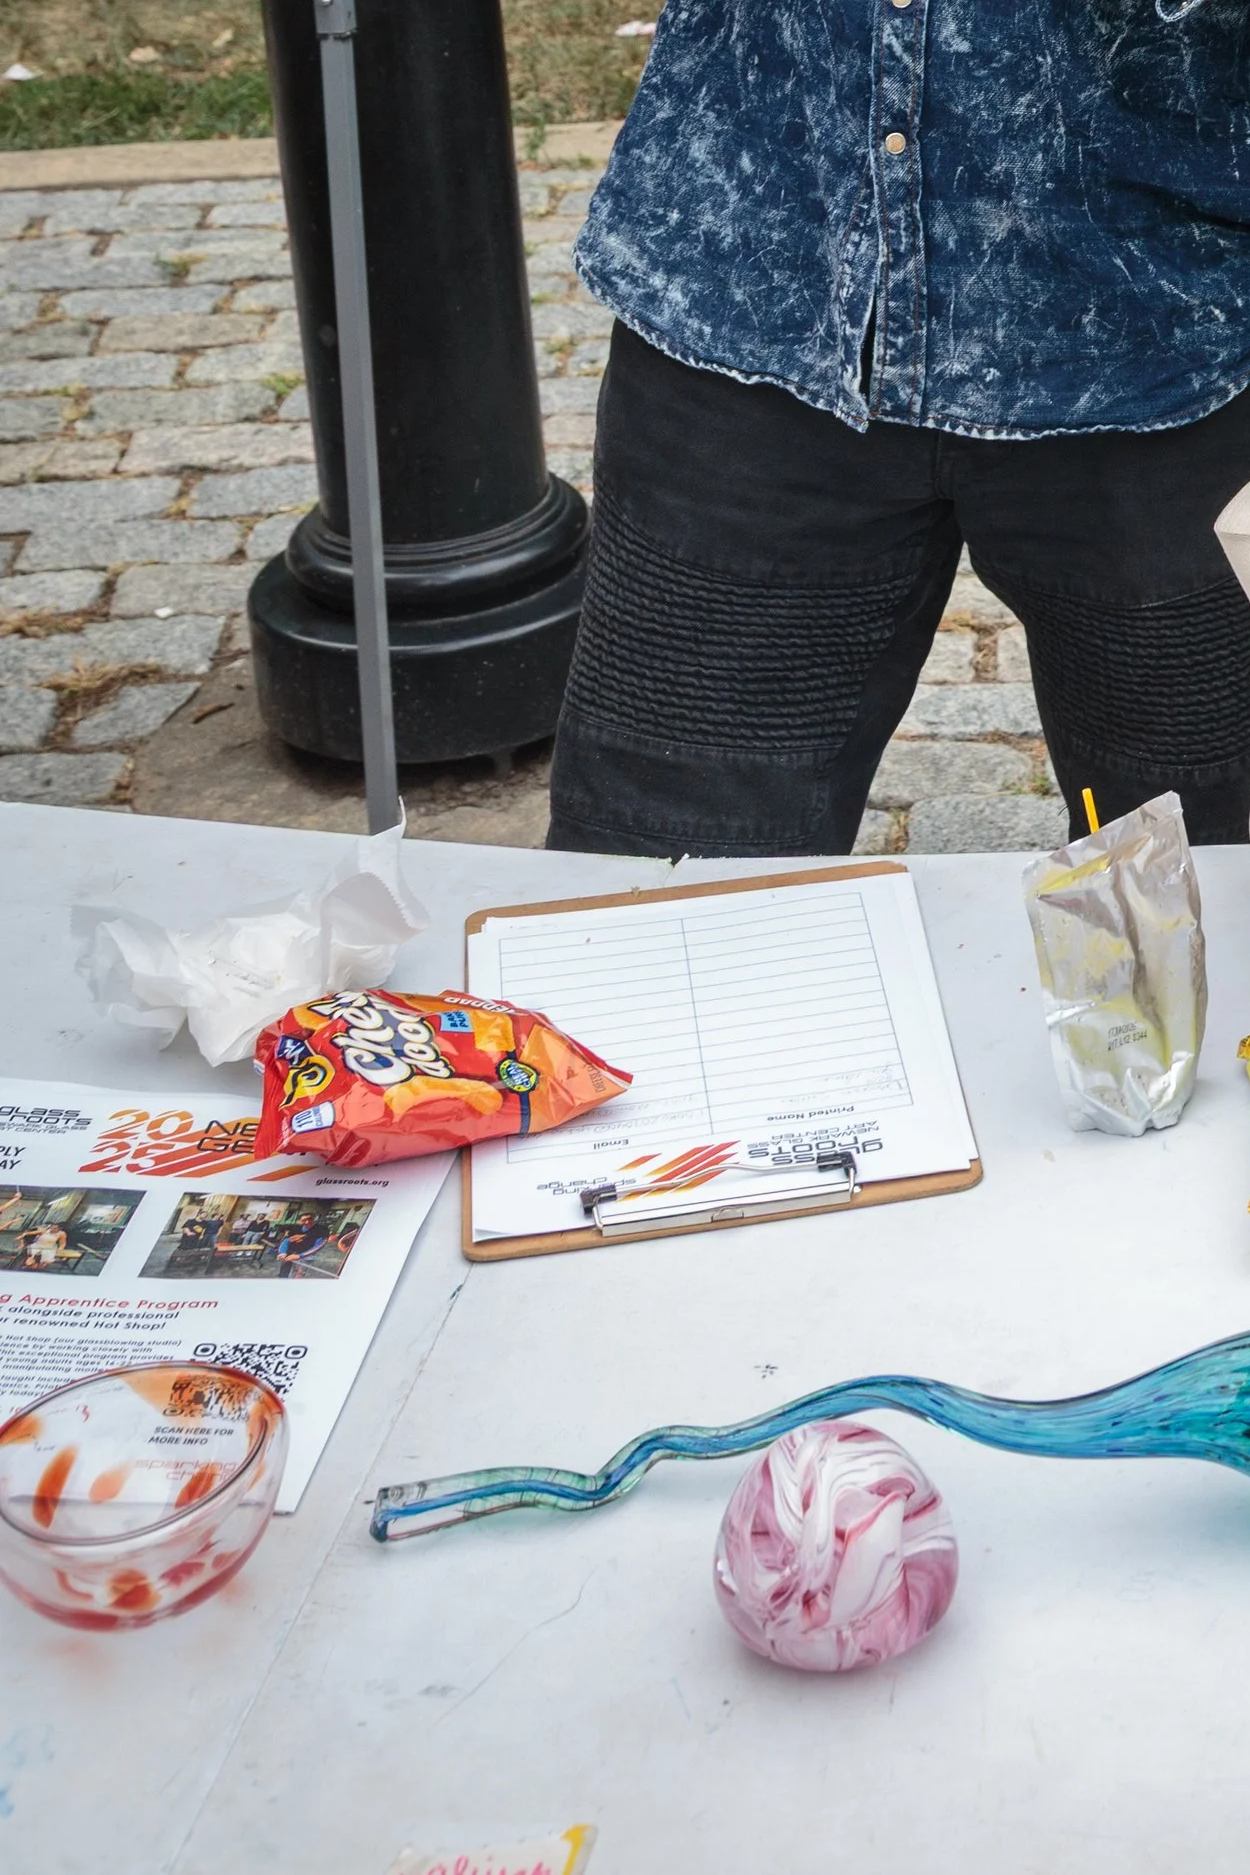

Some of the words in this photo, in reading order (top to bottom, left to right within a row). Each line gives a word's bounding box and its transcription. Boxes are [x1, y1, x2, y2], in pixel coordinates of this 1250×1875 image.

[766, 1112, 804, 1121] Name
[808, 1105, 854, 1118] Printed
[98, 1109, 193, 1140] 20
[846, 1120, 877, 1130] ART
[770, 1127, 840, 1140] CENTER
[809, 1125, 879, 1141] NEWARK
[593, 1138, 629, 1149] Email
[746, 1137, 806, 1148] GLASS
[315, 1176, 389, 1187] glassroots.org
[18, 1294, 129, 1308] Apprentice
[136, 1299, 218, 1310] Program
[8, 1306, 82, 1317] alongside
[86, 1310, 179, 1319] professional
[13, 1316, 90, 1328] renowned
[93, 1320, 119, 1329] Hot
[123, 1321, 166, 1331] Shop!
[154, 1426, 184, 1434] SCAN
[148, 1436, 181, 1444] MORE
[182, 1437, 208, 1445] INFO
